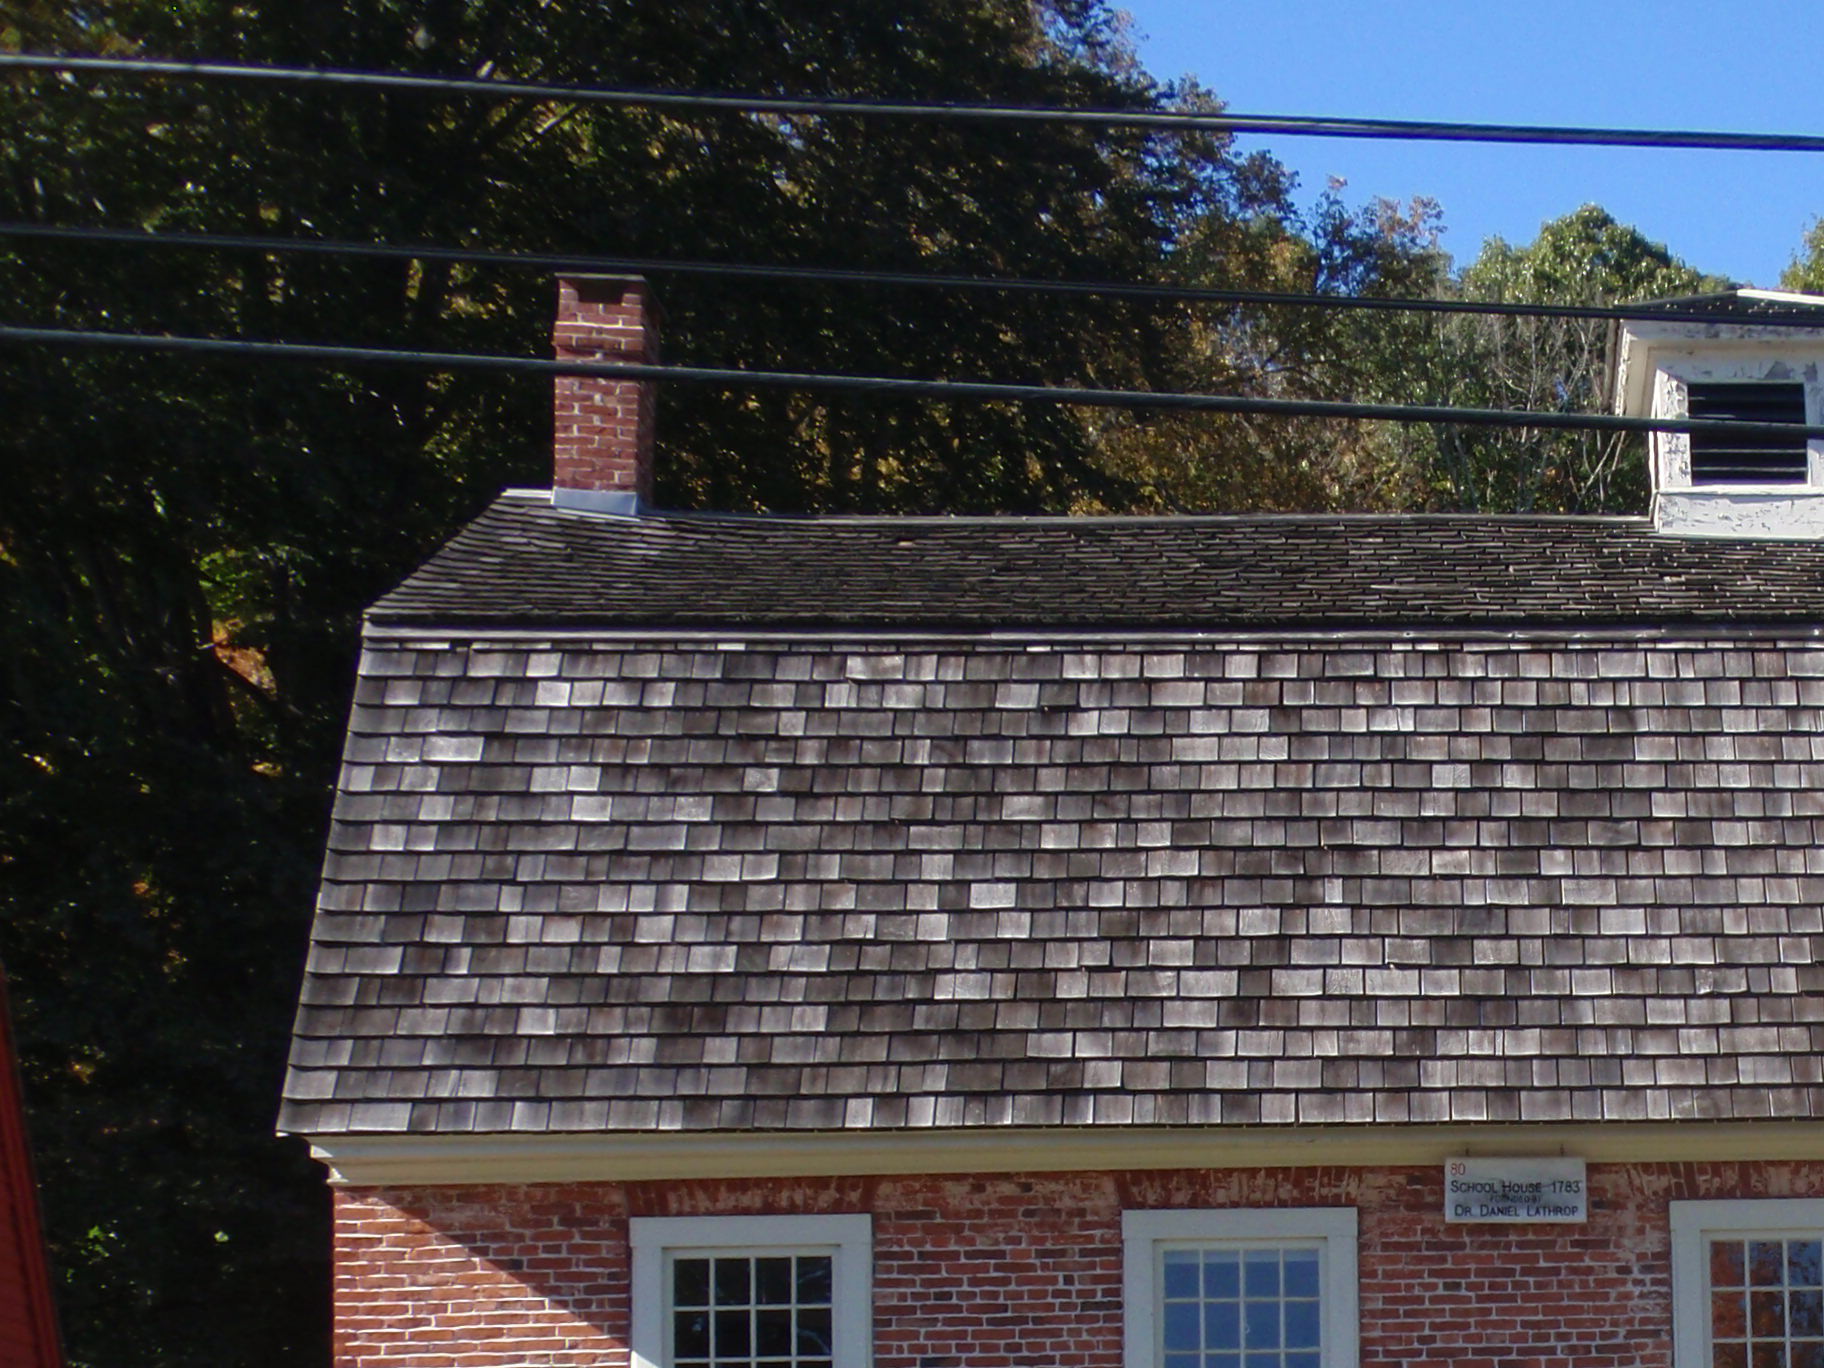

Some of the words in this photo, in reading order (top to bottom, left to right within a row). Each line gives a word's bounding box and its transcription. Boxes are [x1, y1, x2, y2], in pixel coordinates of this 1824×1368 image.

[1450, 1162, 1466, 1176] 80
[1450, 1179, 1498, 1193] SCHOOL
[1502, 1179, 1542, 1193] HOUSE
[1552, 1180, 1581, 1193] 1783
[1480, 1204, 1520, 1217] DANIEL
[1527, 1204, 1579, 1217] LATHROP
